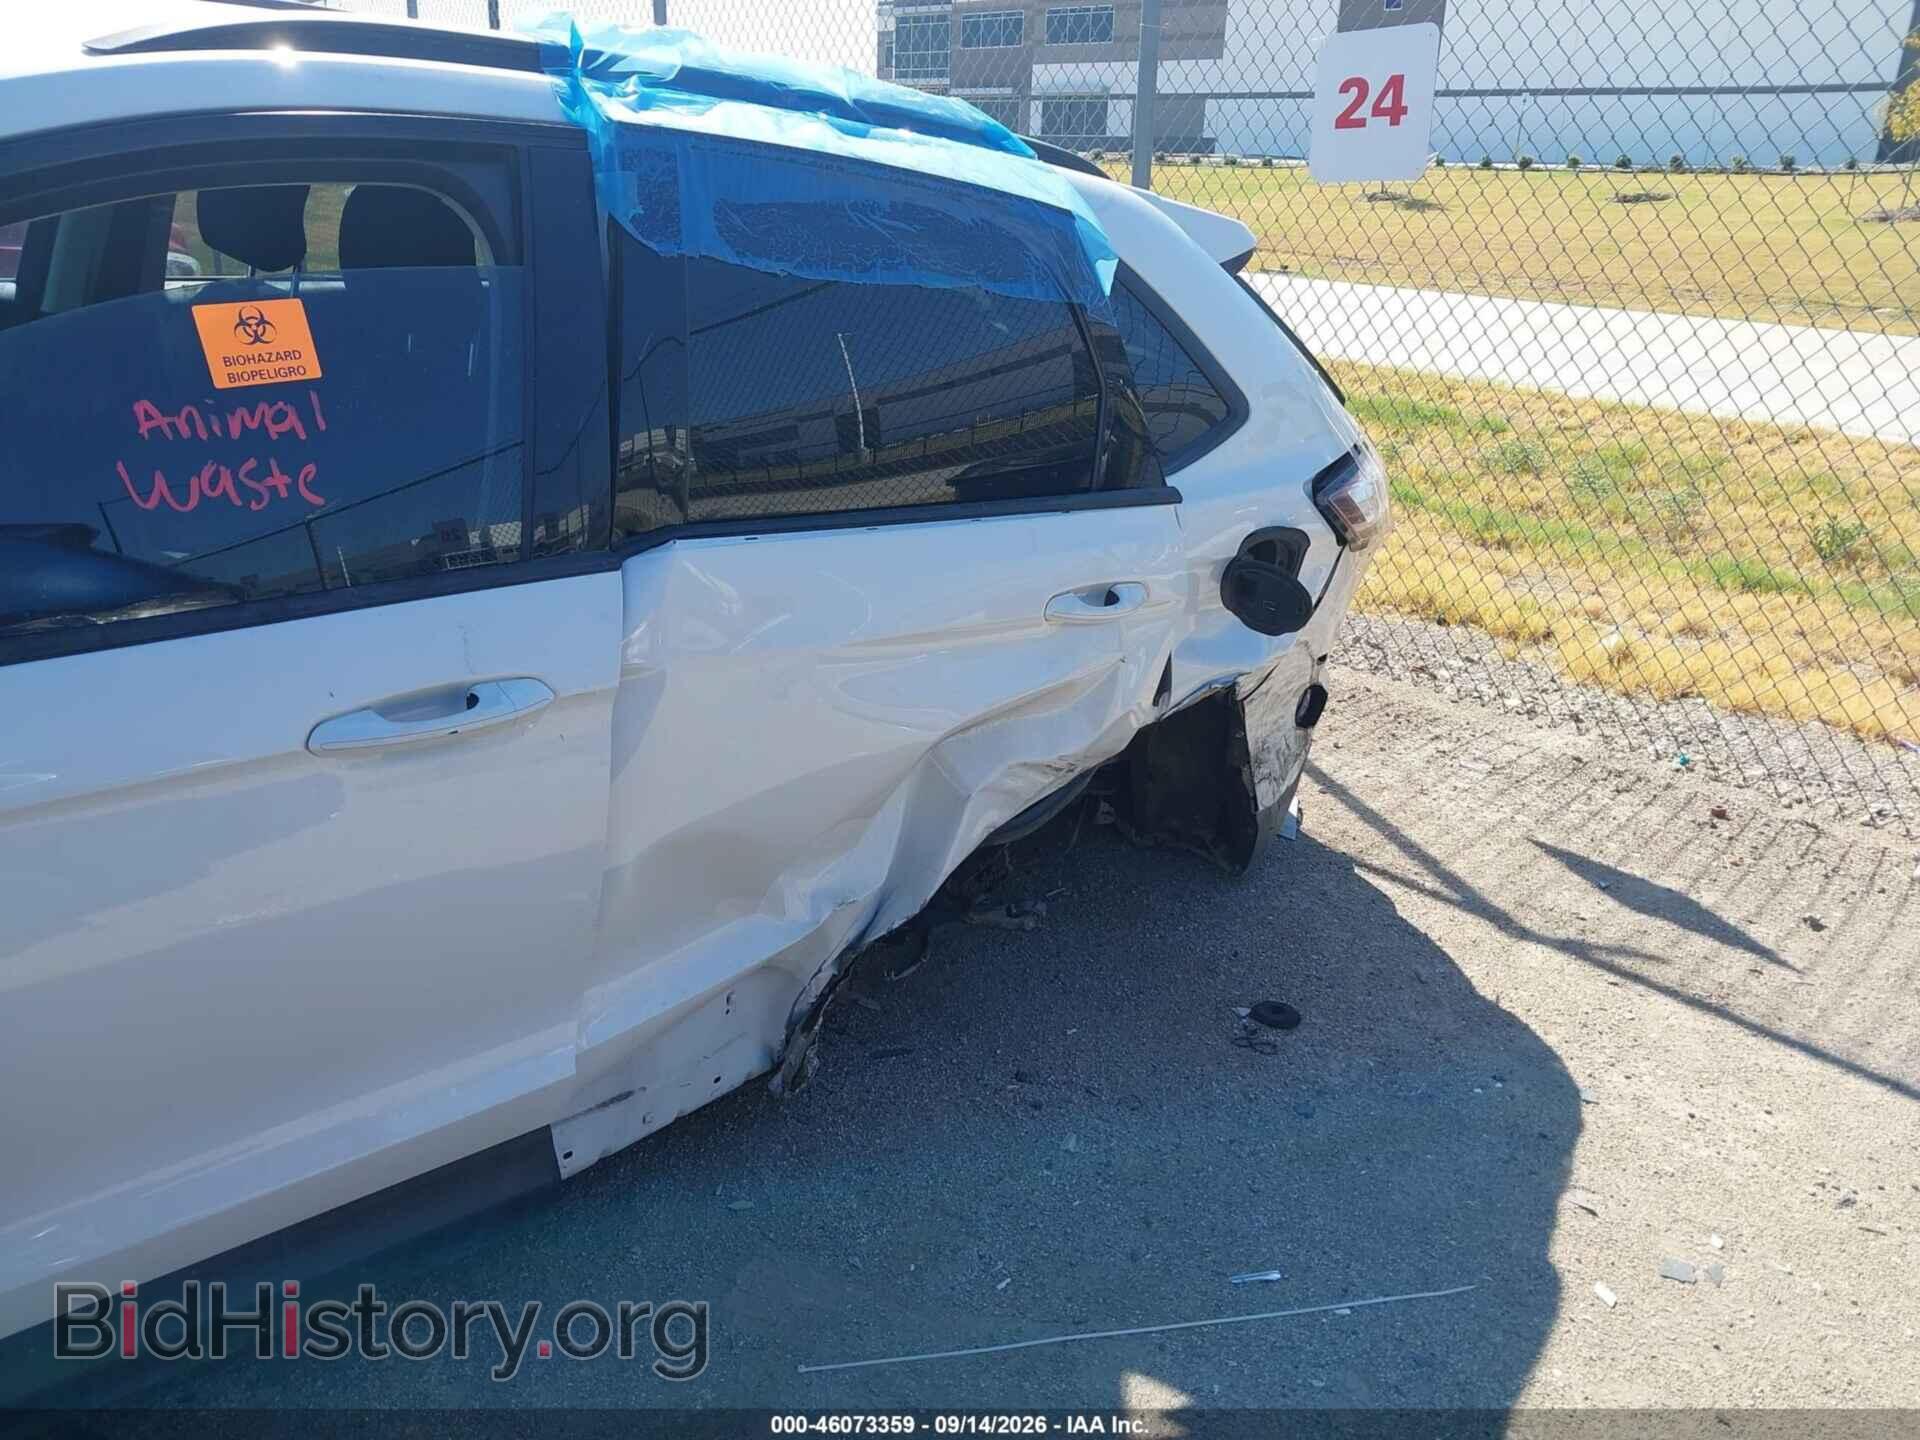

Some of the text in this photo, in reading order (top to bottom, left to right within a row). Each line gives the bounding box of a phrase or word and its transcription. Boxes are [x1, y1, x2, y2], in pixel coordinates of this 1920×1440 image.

[1334, 74, 1409, 129] 24
[222, 349, 302, 367] BIOHAZARD
[227, 365, 306, 384] BIOPELIGRO
[133, 390, 327, 440] Animal
